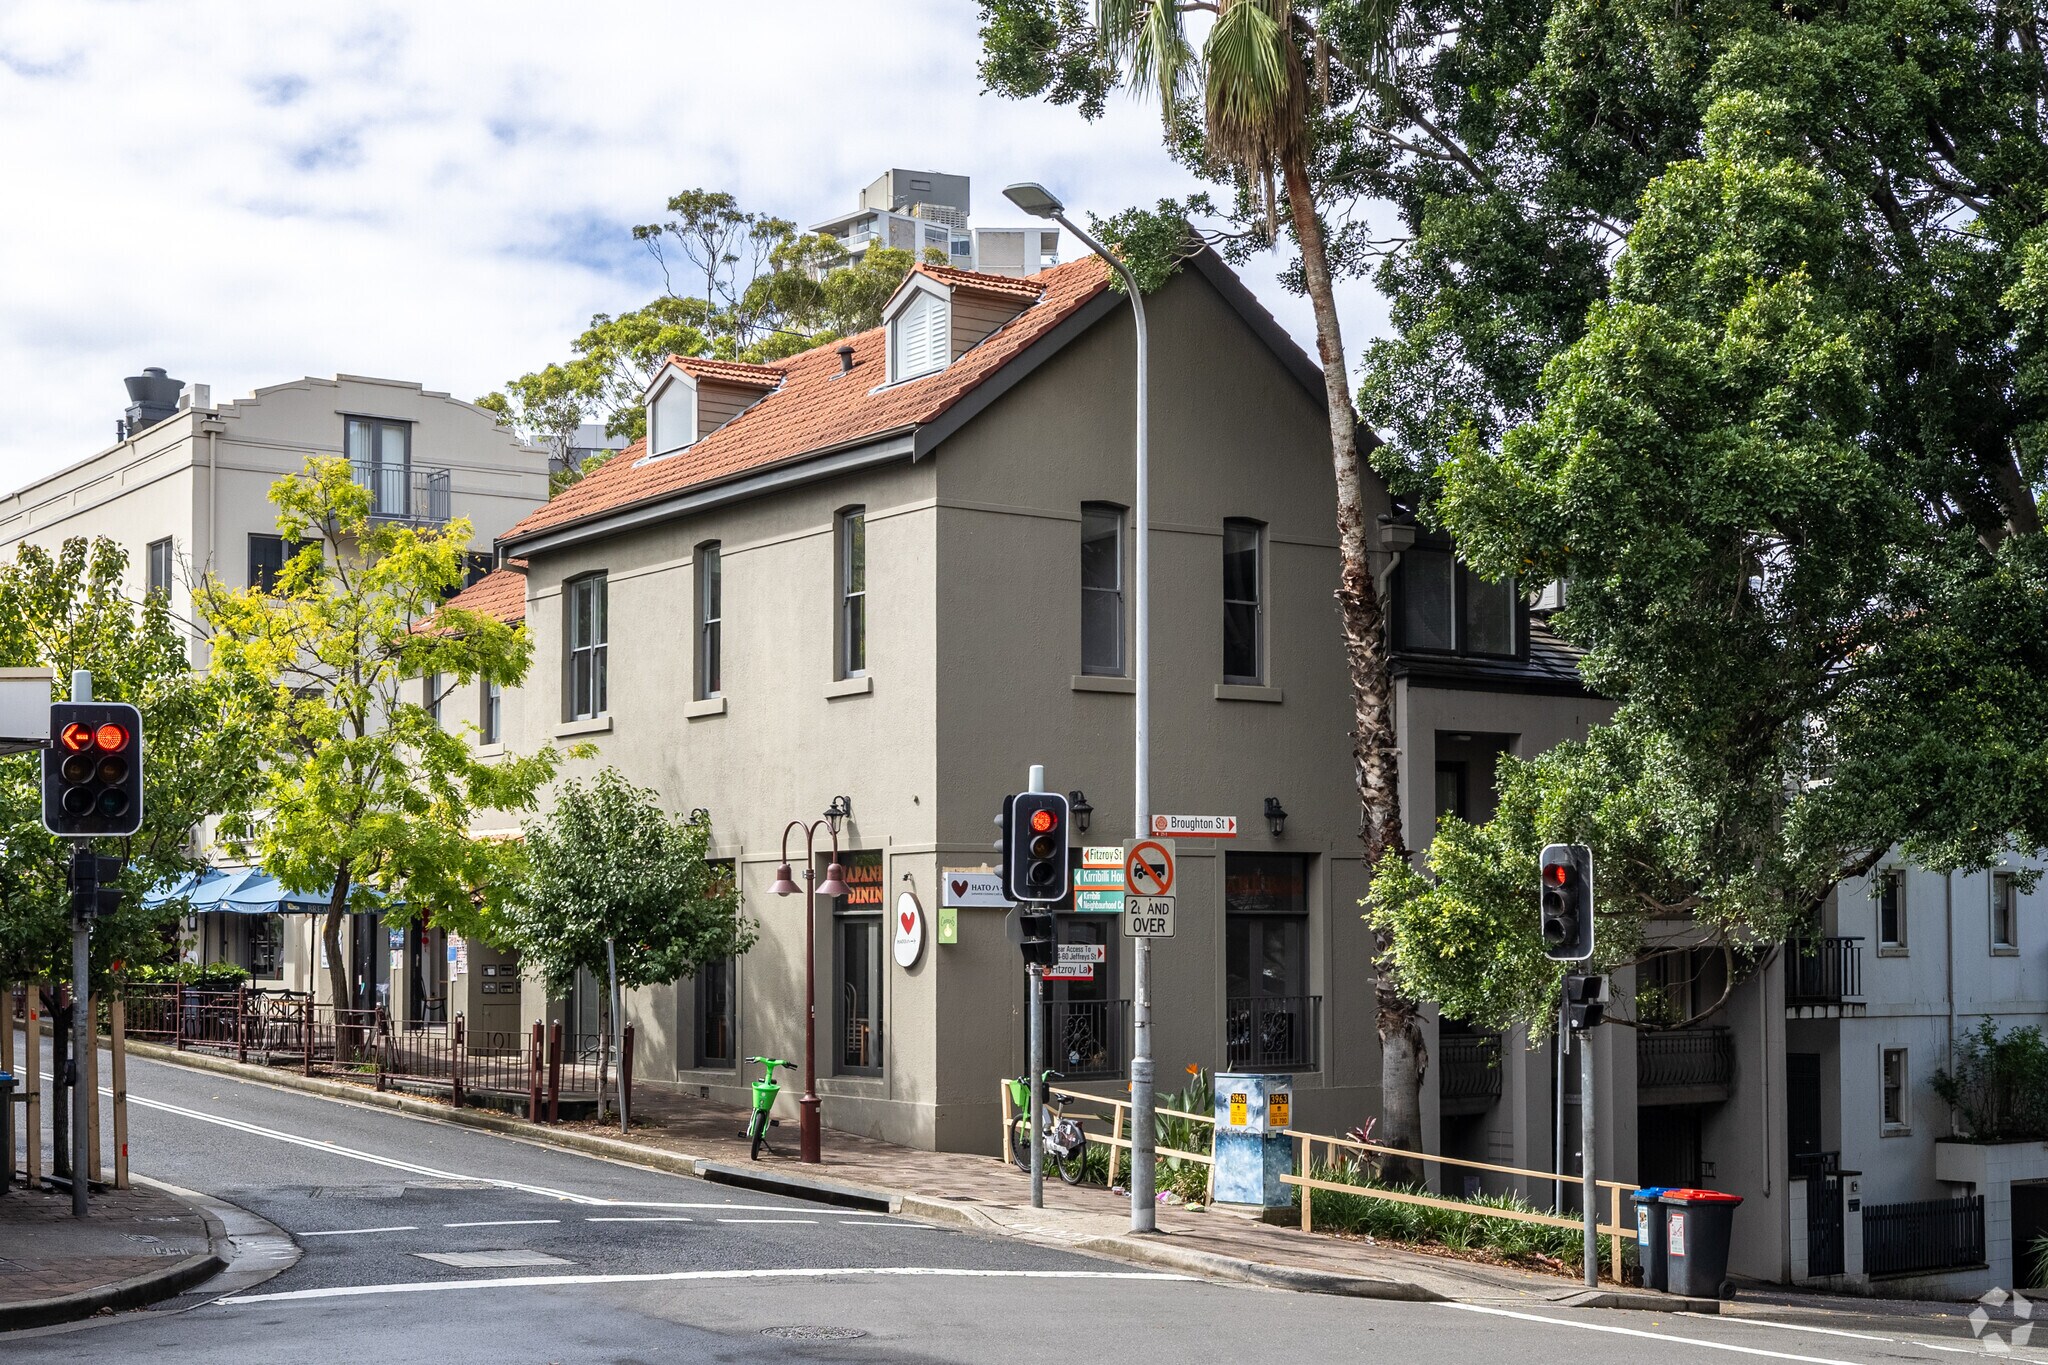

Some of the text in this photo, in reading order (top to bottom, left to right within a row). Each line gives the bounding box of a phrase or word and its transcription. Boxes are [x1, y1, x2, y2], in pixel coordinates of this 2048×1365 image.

[1171, 817, 1225, 831] Broughton St
[1090, 848, 1122, 862] Fitzroy St
[1131, 900, 1169, 915] 2t AND
[1133, 918, 1166, 933] OVER
[1070, 953, 1090, 961] Jeffreys
[1091, 953, 1097, 961] St
[1079, 964, 1088, 974] La
[1231, 1094, 1246, 1103] 3963
[1271, 1094, 1287, 1104] 3963
